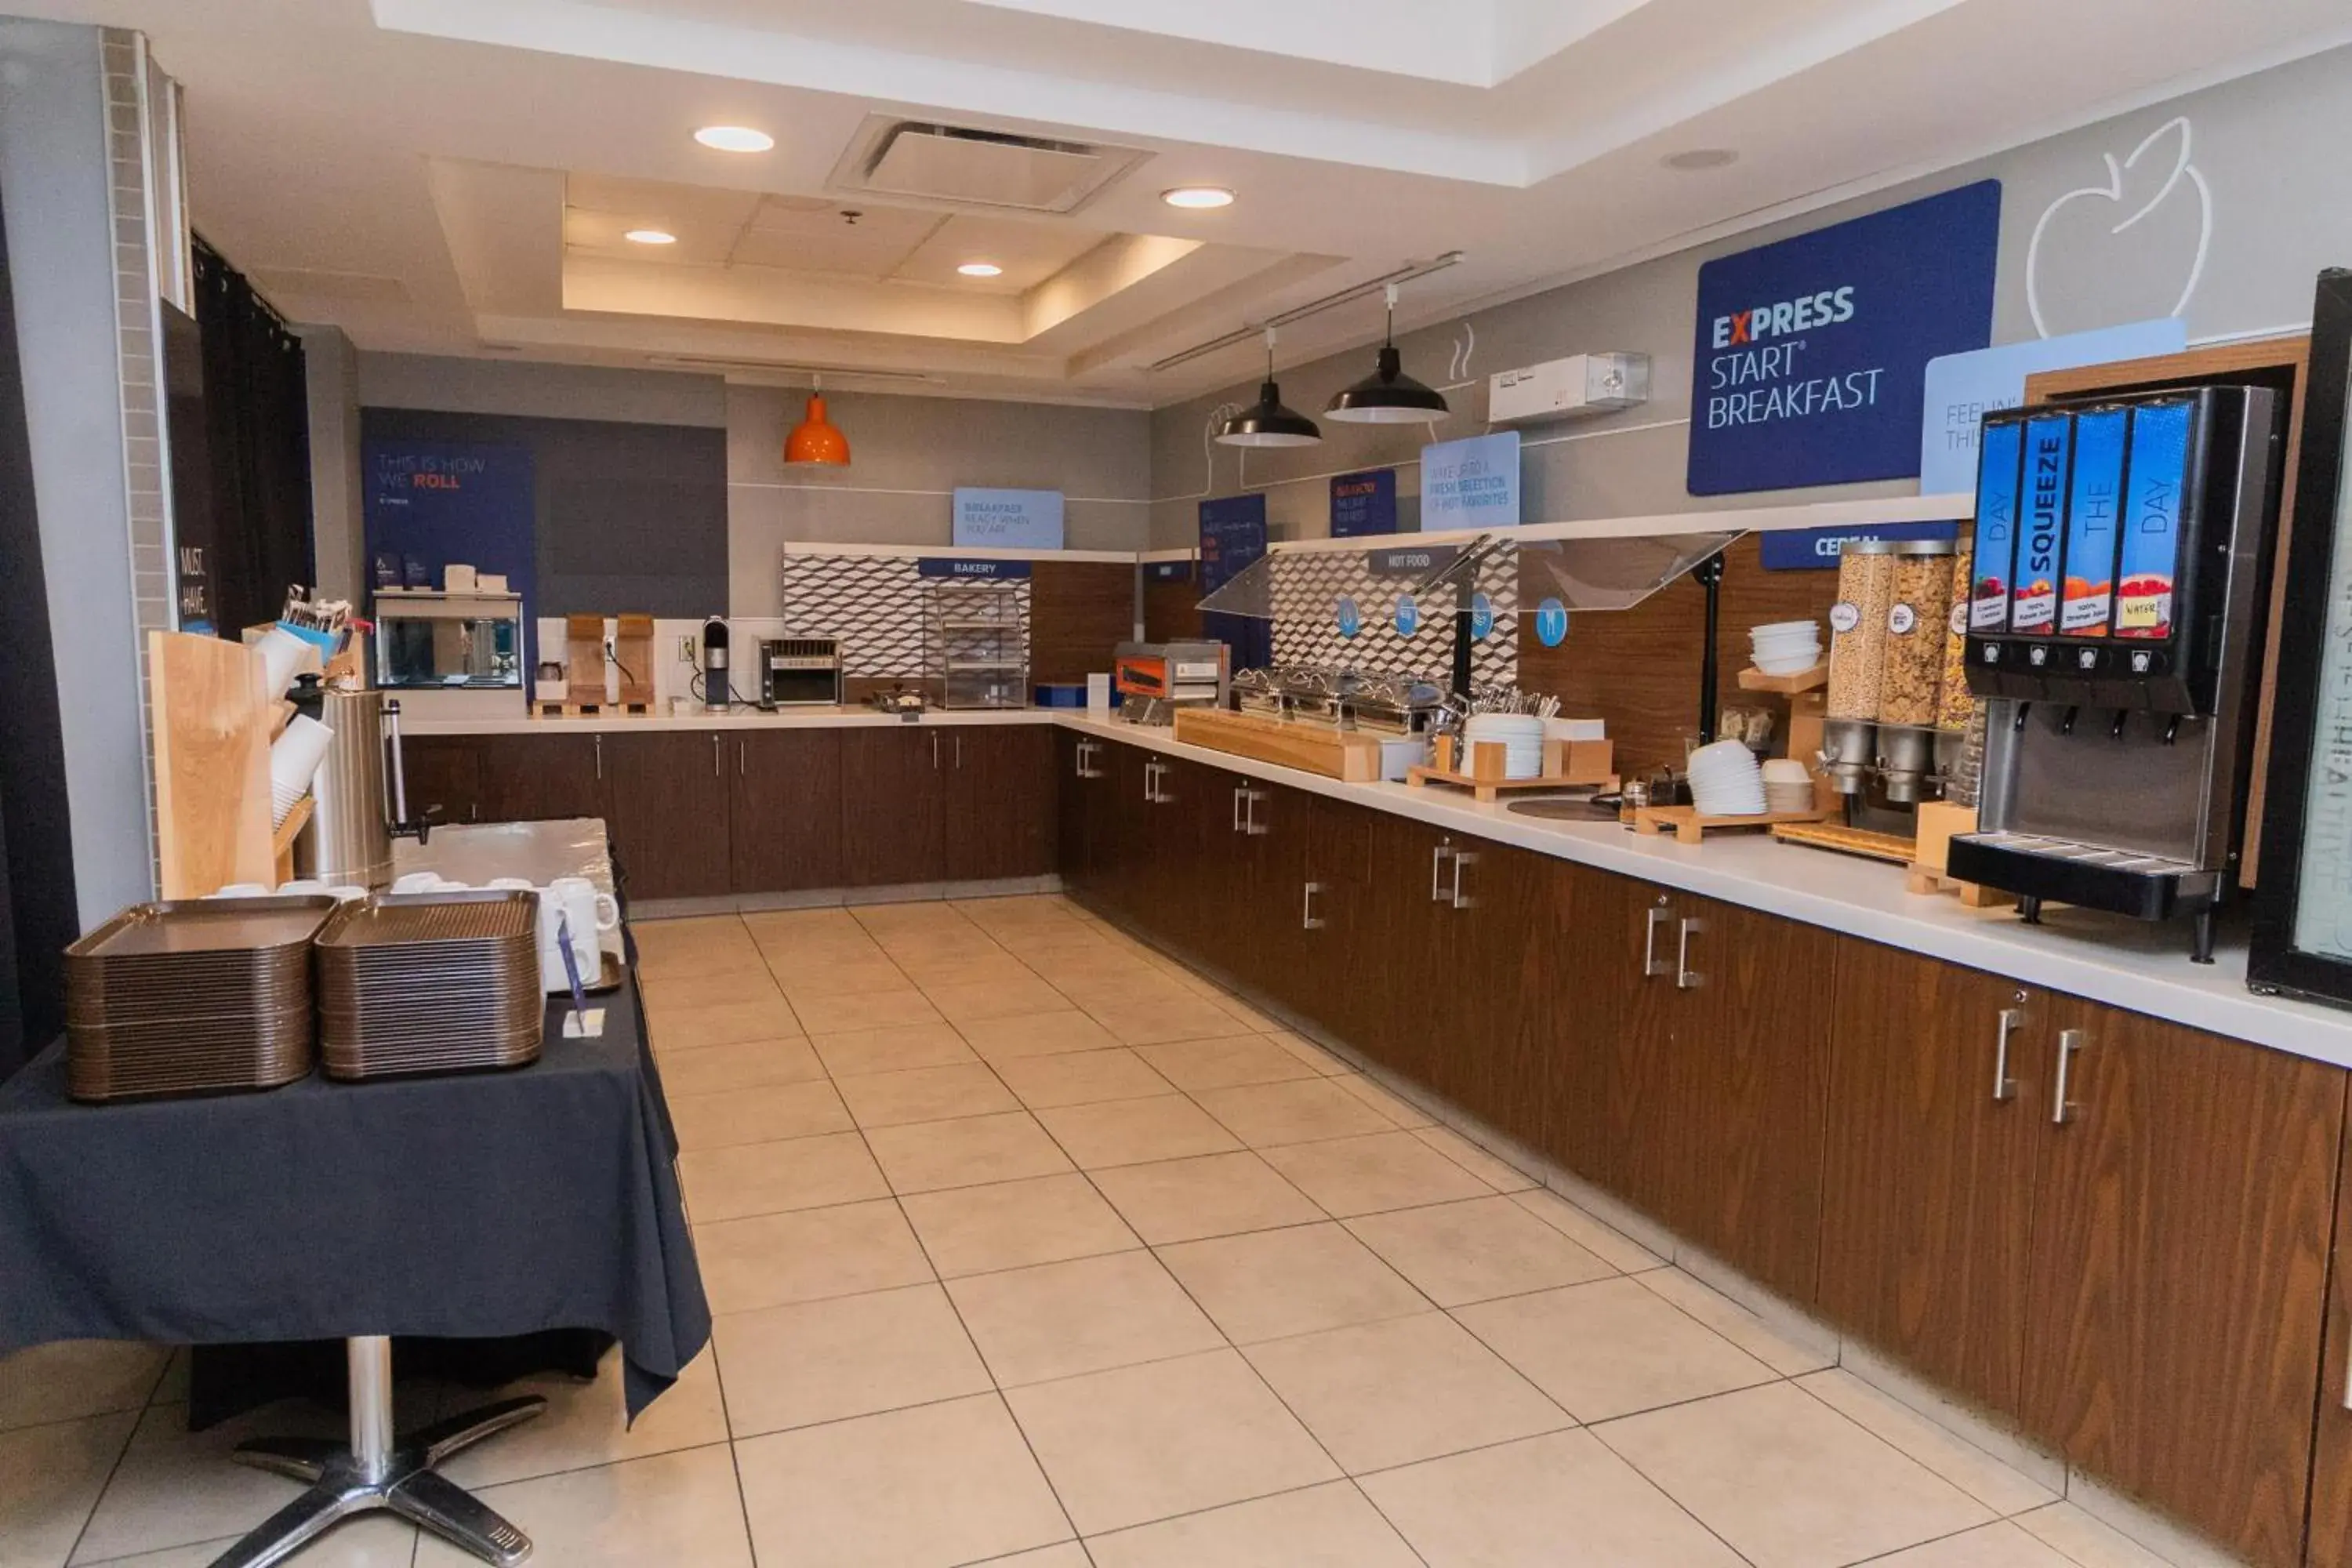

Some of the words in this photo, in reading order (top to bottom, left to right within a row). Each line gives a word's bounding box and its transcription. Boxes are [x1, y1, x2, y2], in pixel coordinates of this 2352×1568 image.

[1712, 285, 1855, 350] EXPRESS
[1708, 368, 1884, 430] BREAKFAST
[1946, 429, 1980, 451] THI
[413, 474, 462, 488] ROLL
[2030, 436, 2060, 572] SQUEEZE
[2141, 477, 2172, 535] DAY
[1987, 492, 2009, 542] DAY
[2085, 480, 2113, 538] THE
[954, 562, 996, 574] BAKERY
[1388, 554, 1405, 568] HOT
[1406, 554, 1430, 568] FOOD
[1815, 535, 1879, 556] CER
